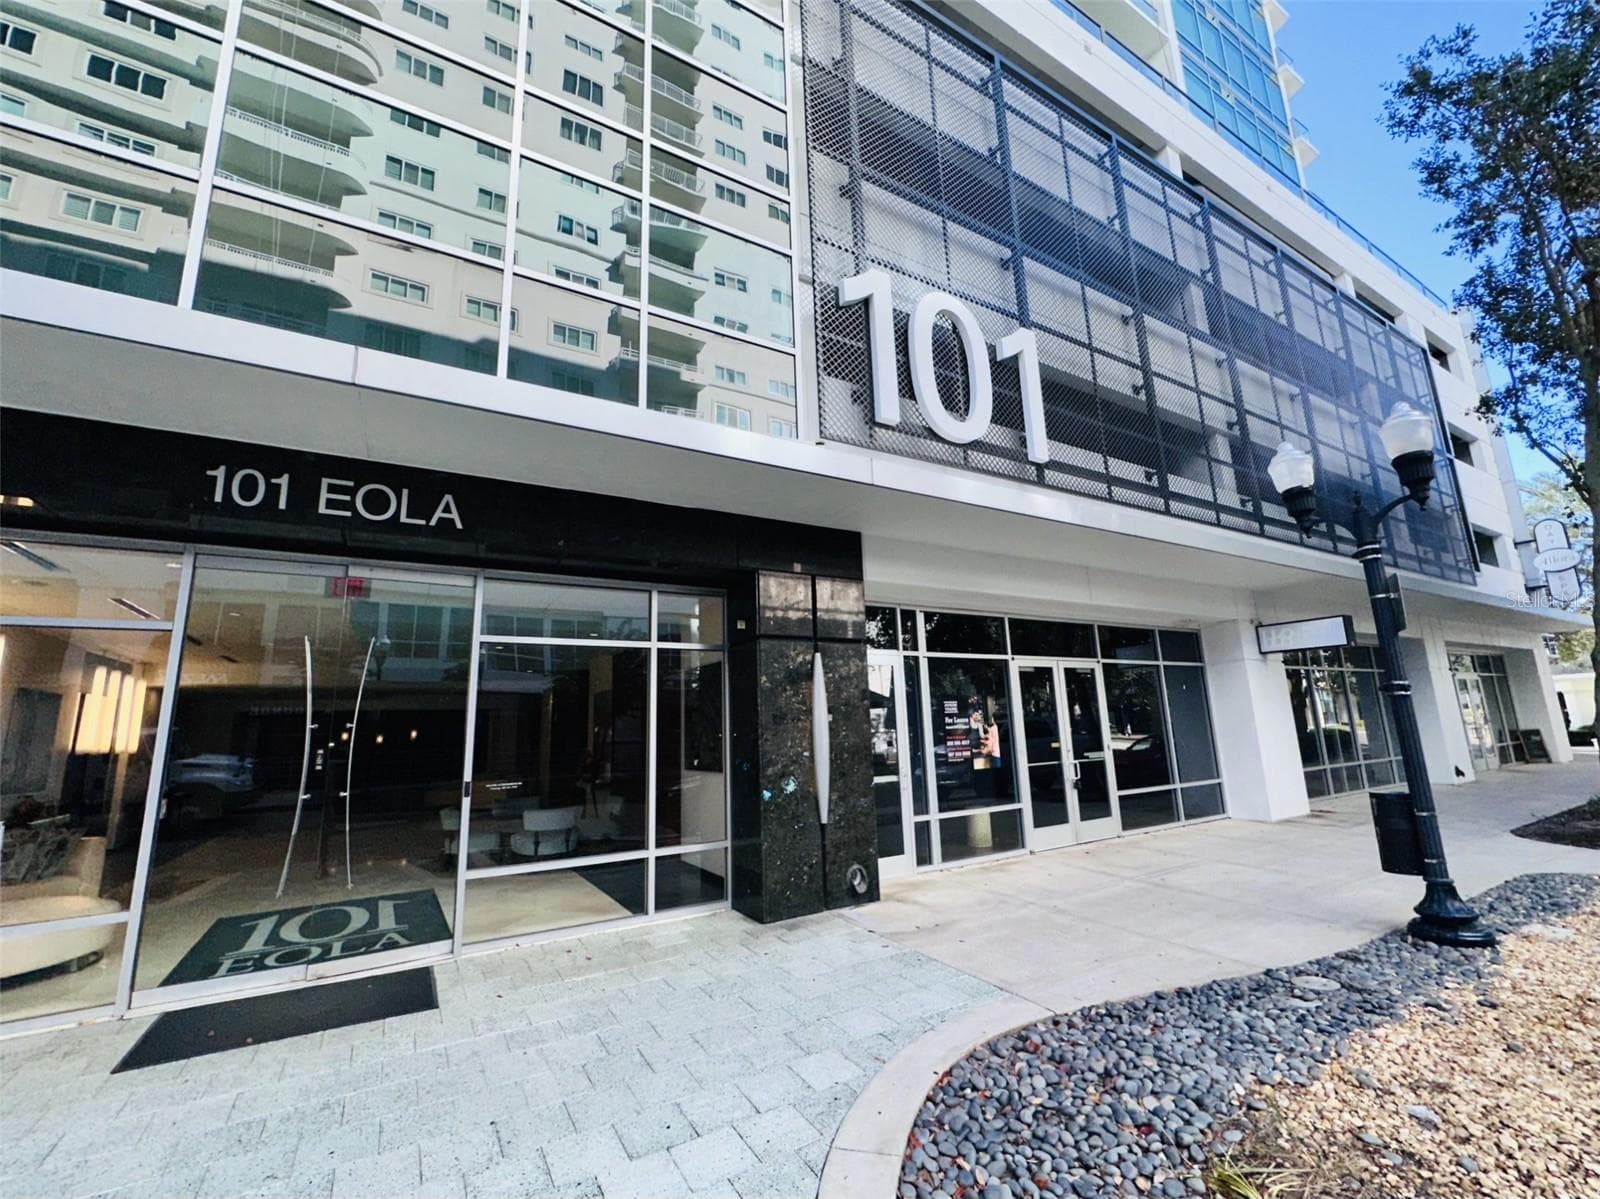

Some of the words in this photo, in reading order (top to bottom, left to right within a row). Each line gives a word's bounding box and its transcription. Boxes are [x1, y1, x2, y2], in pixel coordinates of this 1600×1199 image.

[839, 268, 1049, 463] 101
[206, 465, 289, 510] 101
[318, 477, 463, 529] EOLA
[208, 932, 412, 979] EOLA
[225, 900, 408, 955] 101
